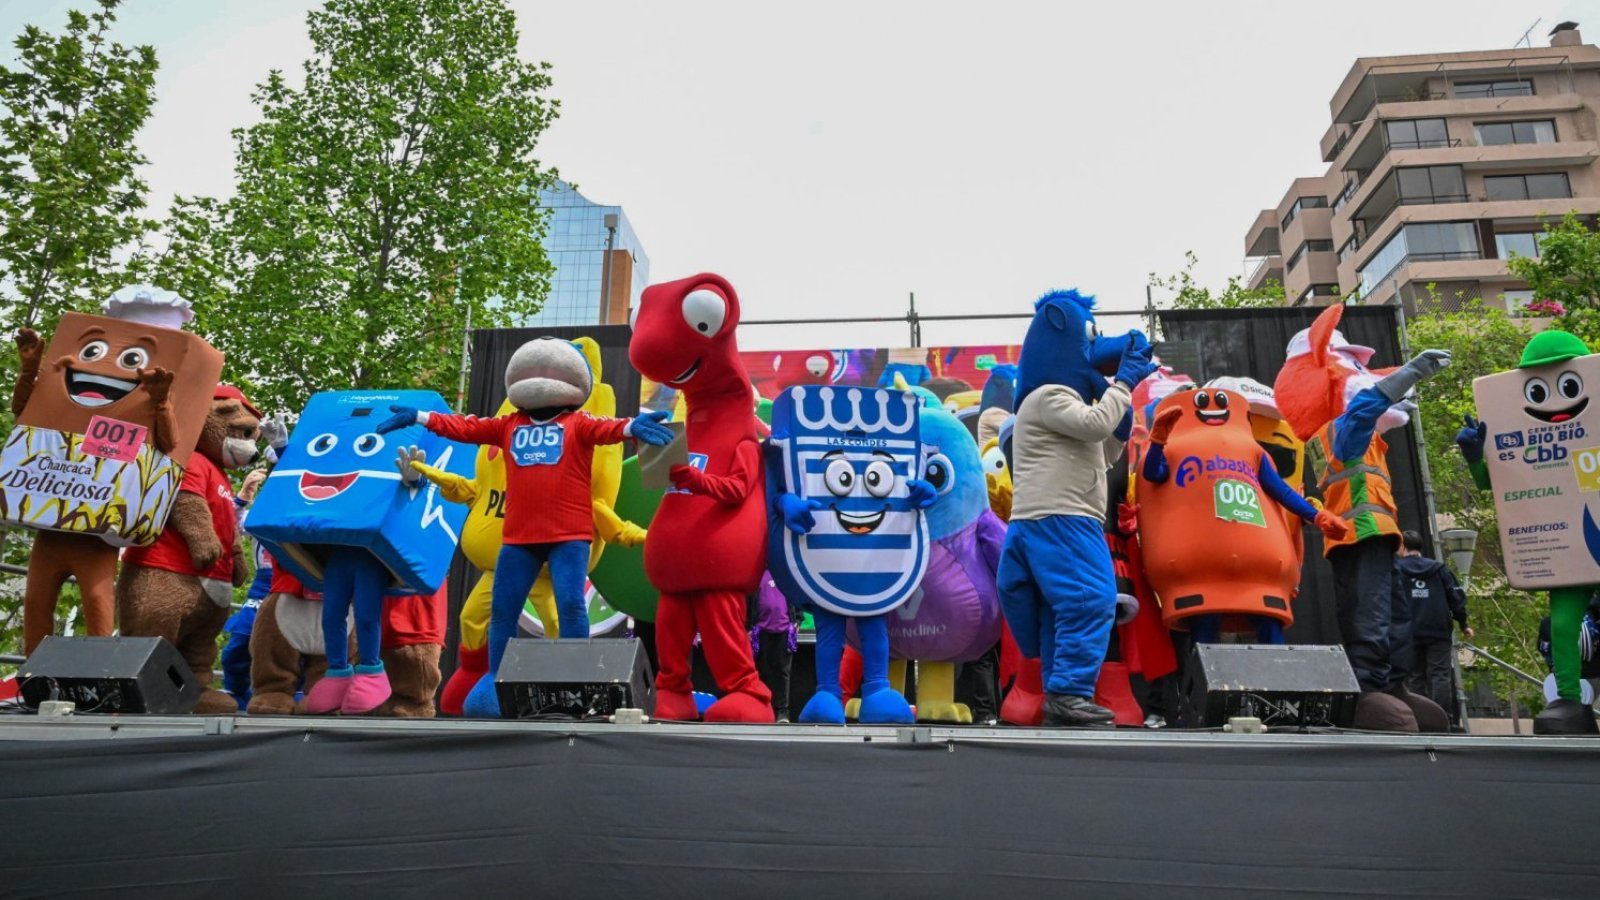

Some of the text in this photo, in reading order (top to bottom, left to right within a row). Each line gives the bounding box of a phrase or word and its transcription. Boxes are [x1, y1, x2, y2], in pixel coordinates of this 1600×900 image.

[92, 420, 139, 446] 001
[1528, 421, 1582, 434] CEMENTOS
[515, 425, 560, 449] 005
[827, 437, 888, 448] LAS CONDES
[1528, 433, 1554, 446] BIO
[1499, 451, 1516, 461] es
[38, 456, 92, 475] Chancaca
[1532, 461, 1569, 471] Cementos
[6, 469, 112, 500] Deliciosa
[1219, 482, 1259, 510] 002
[1504, 486, 1563, 502] ESPECIAL
[1508, 522, 1569, 536] BENEFICIOS:
